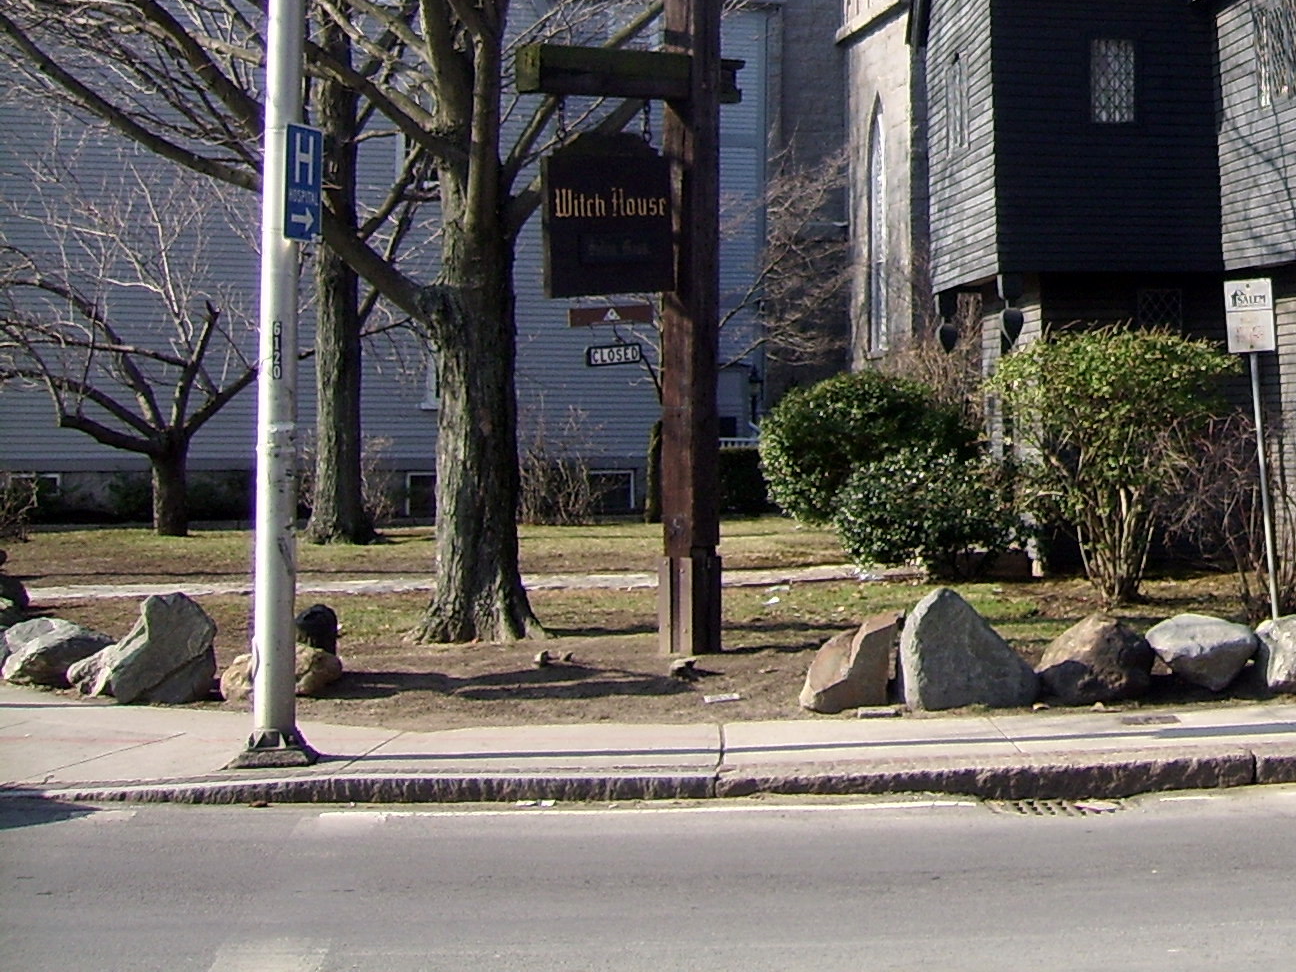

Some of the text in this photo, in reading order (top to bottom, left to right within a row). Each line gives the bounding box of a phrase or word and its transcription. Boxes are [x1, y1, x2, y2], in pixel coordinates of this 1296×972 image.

[295, 132, 314, 186] H
[555, 187, 666, 218] Witch House
[1238, 294, 1266, 304] SALEM
[273, 322, 281, 379] 6120
[592, 346, 638, 363] CLOSED
